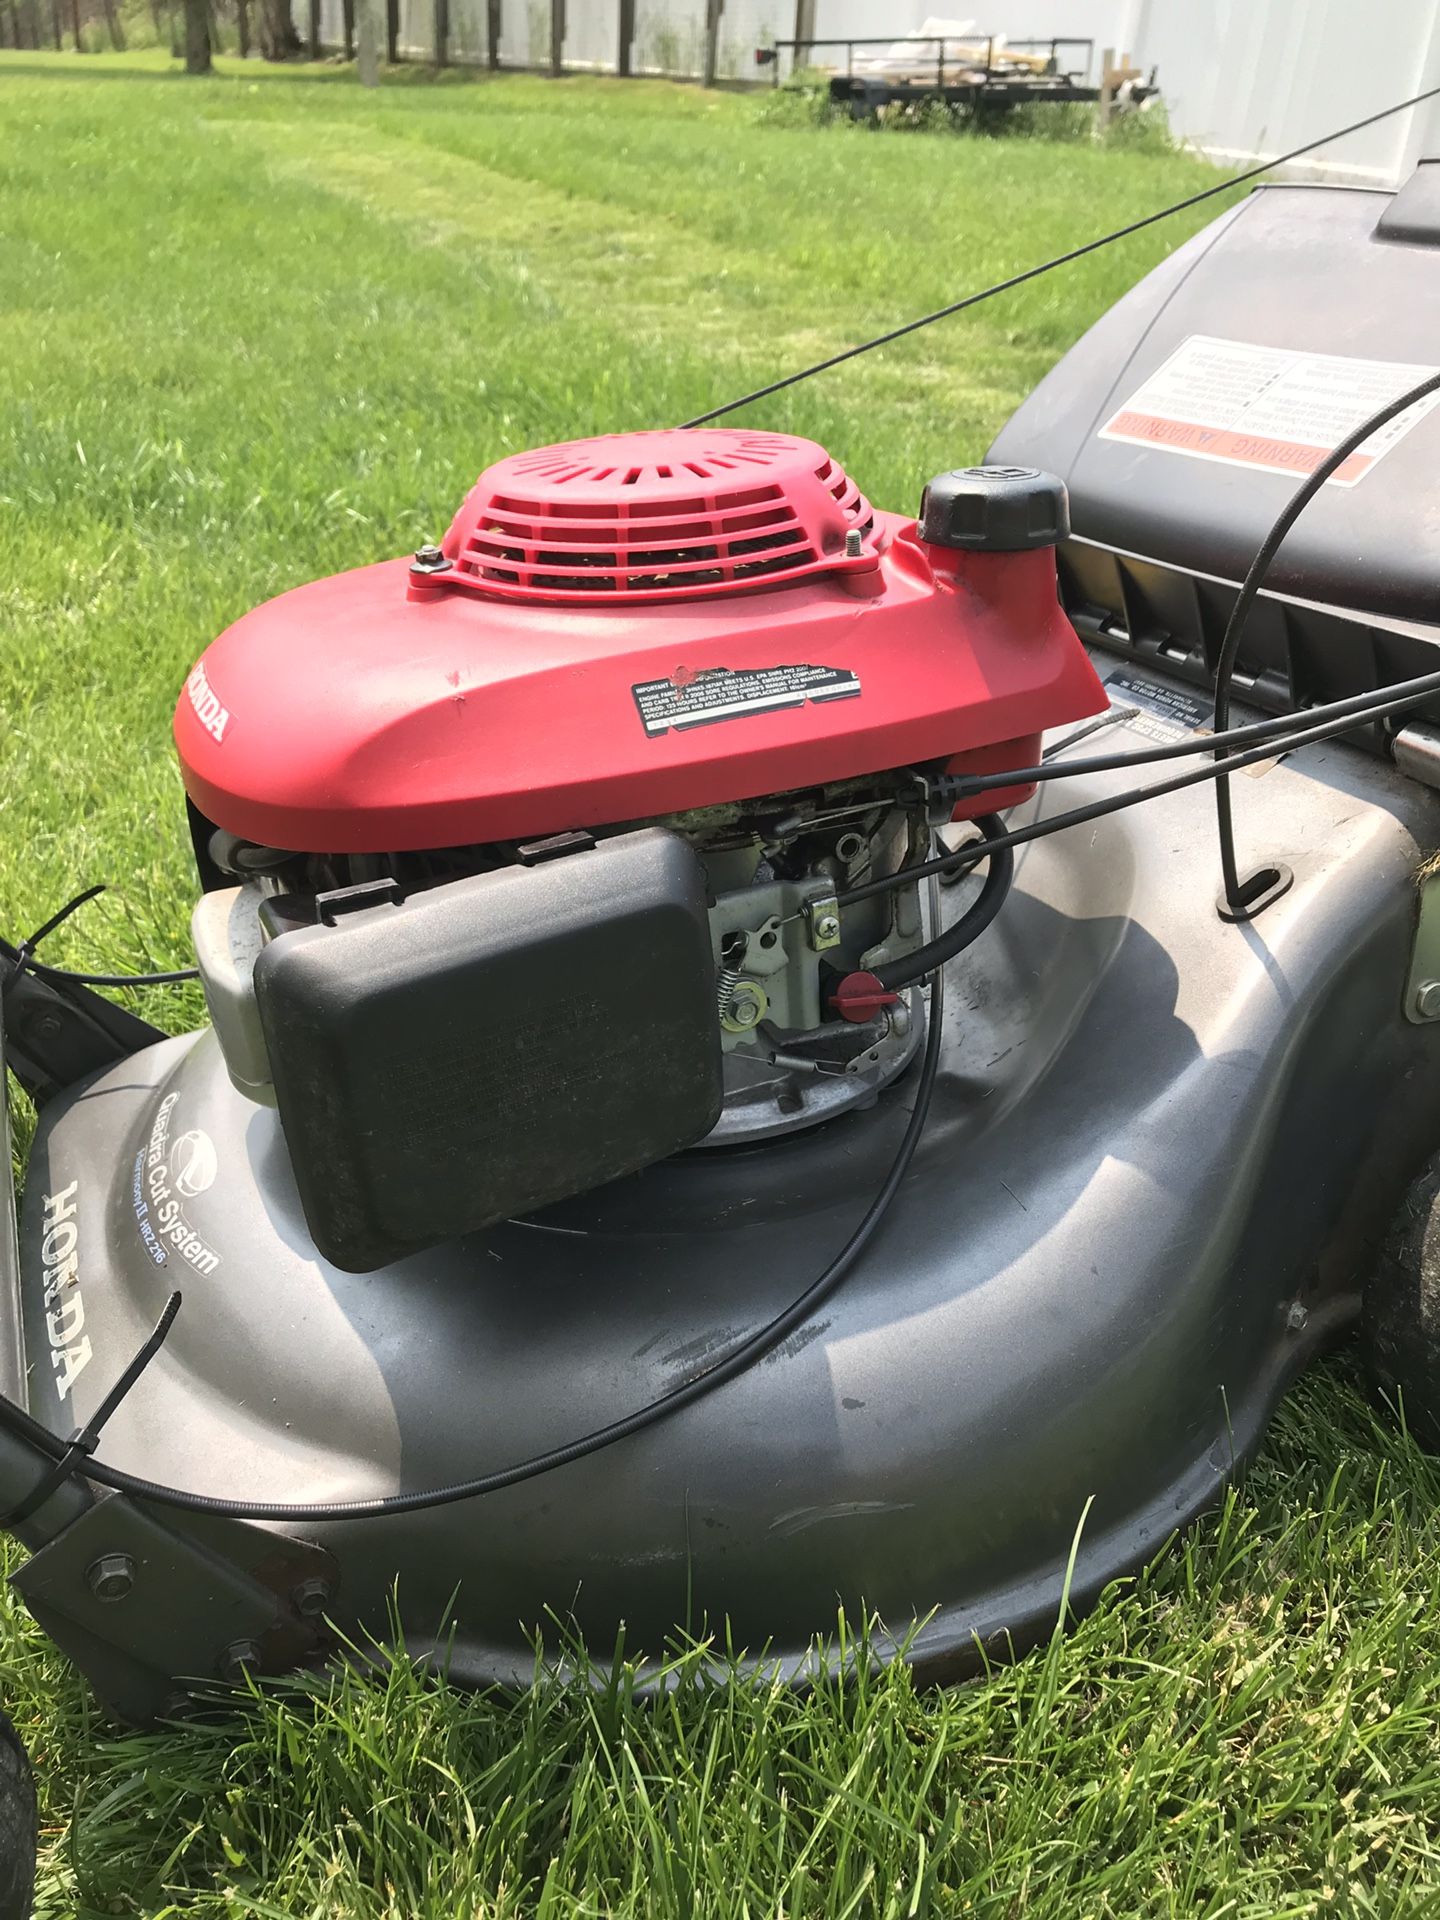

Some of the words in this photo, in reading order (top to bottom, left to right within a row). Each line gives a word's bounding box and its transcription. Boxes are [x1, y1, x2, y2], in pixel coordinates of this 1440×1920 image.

[636, 683, 669, 694] IMPORTANT
[793, 668, 826, 679] COMPLIANCE
[800, 671, 837, 683] MAINTENANCE
[187, 661, 230, 742] HONDA
[645, 705, 690, 720] SPECIFICATIONS
[148, 1091, 180, 1167] Quadra
[148, 1164, 169, 1206] Cut
[139, 1219, 157, 1248] HRZ
[148, 1240, 166, 1265] 216
[158, 1200, 222, 1275] System
[41, 1180, 94, 1402] HONDA
